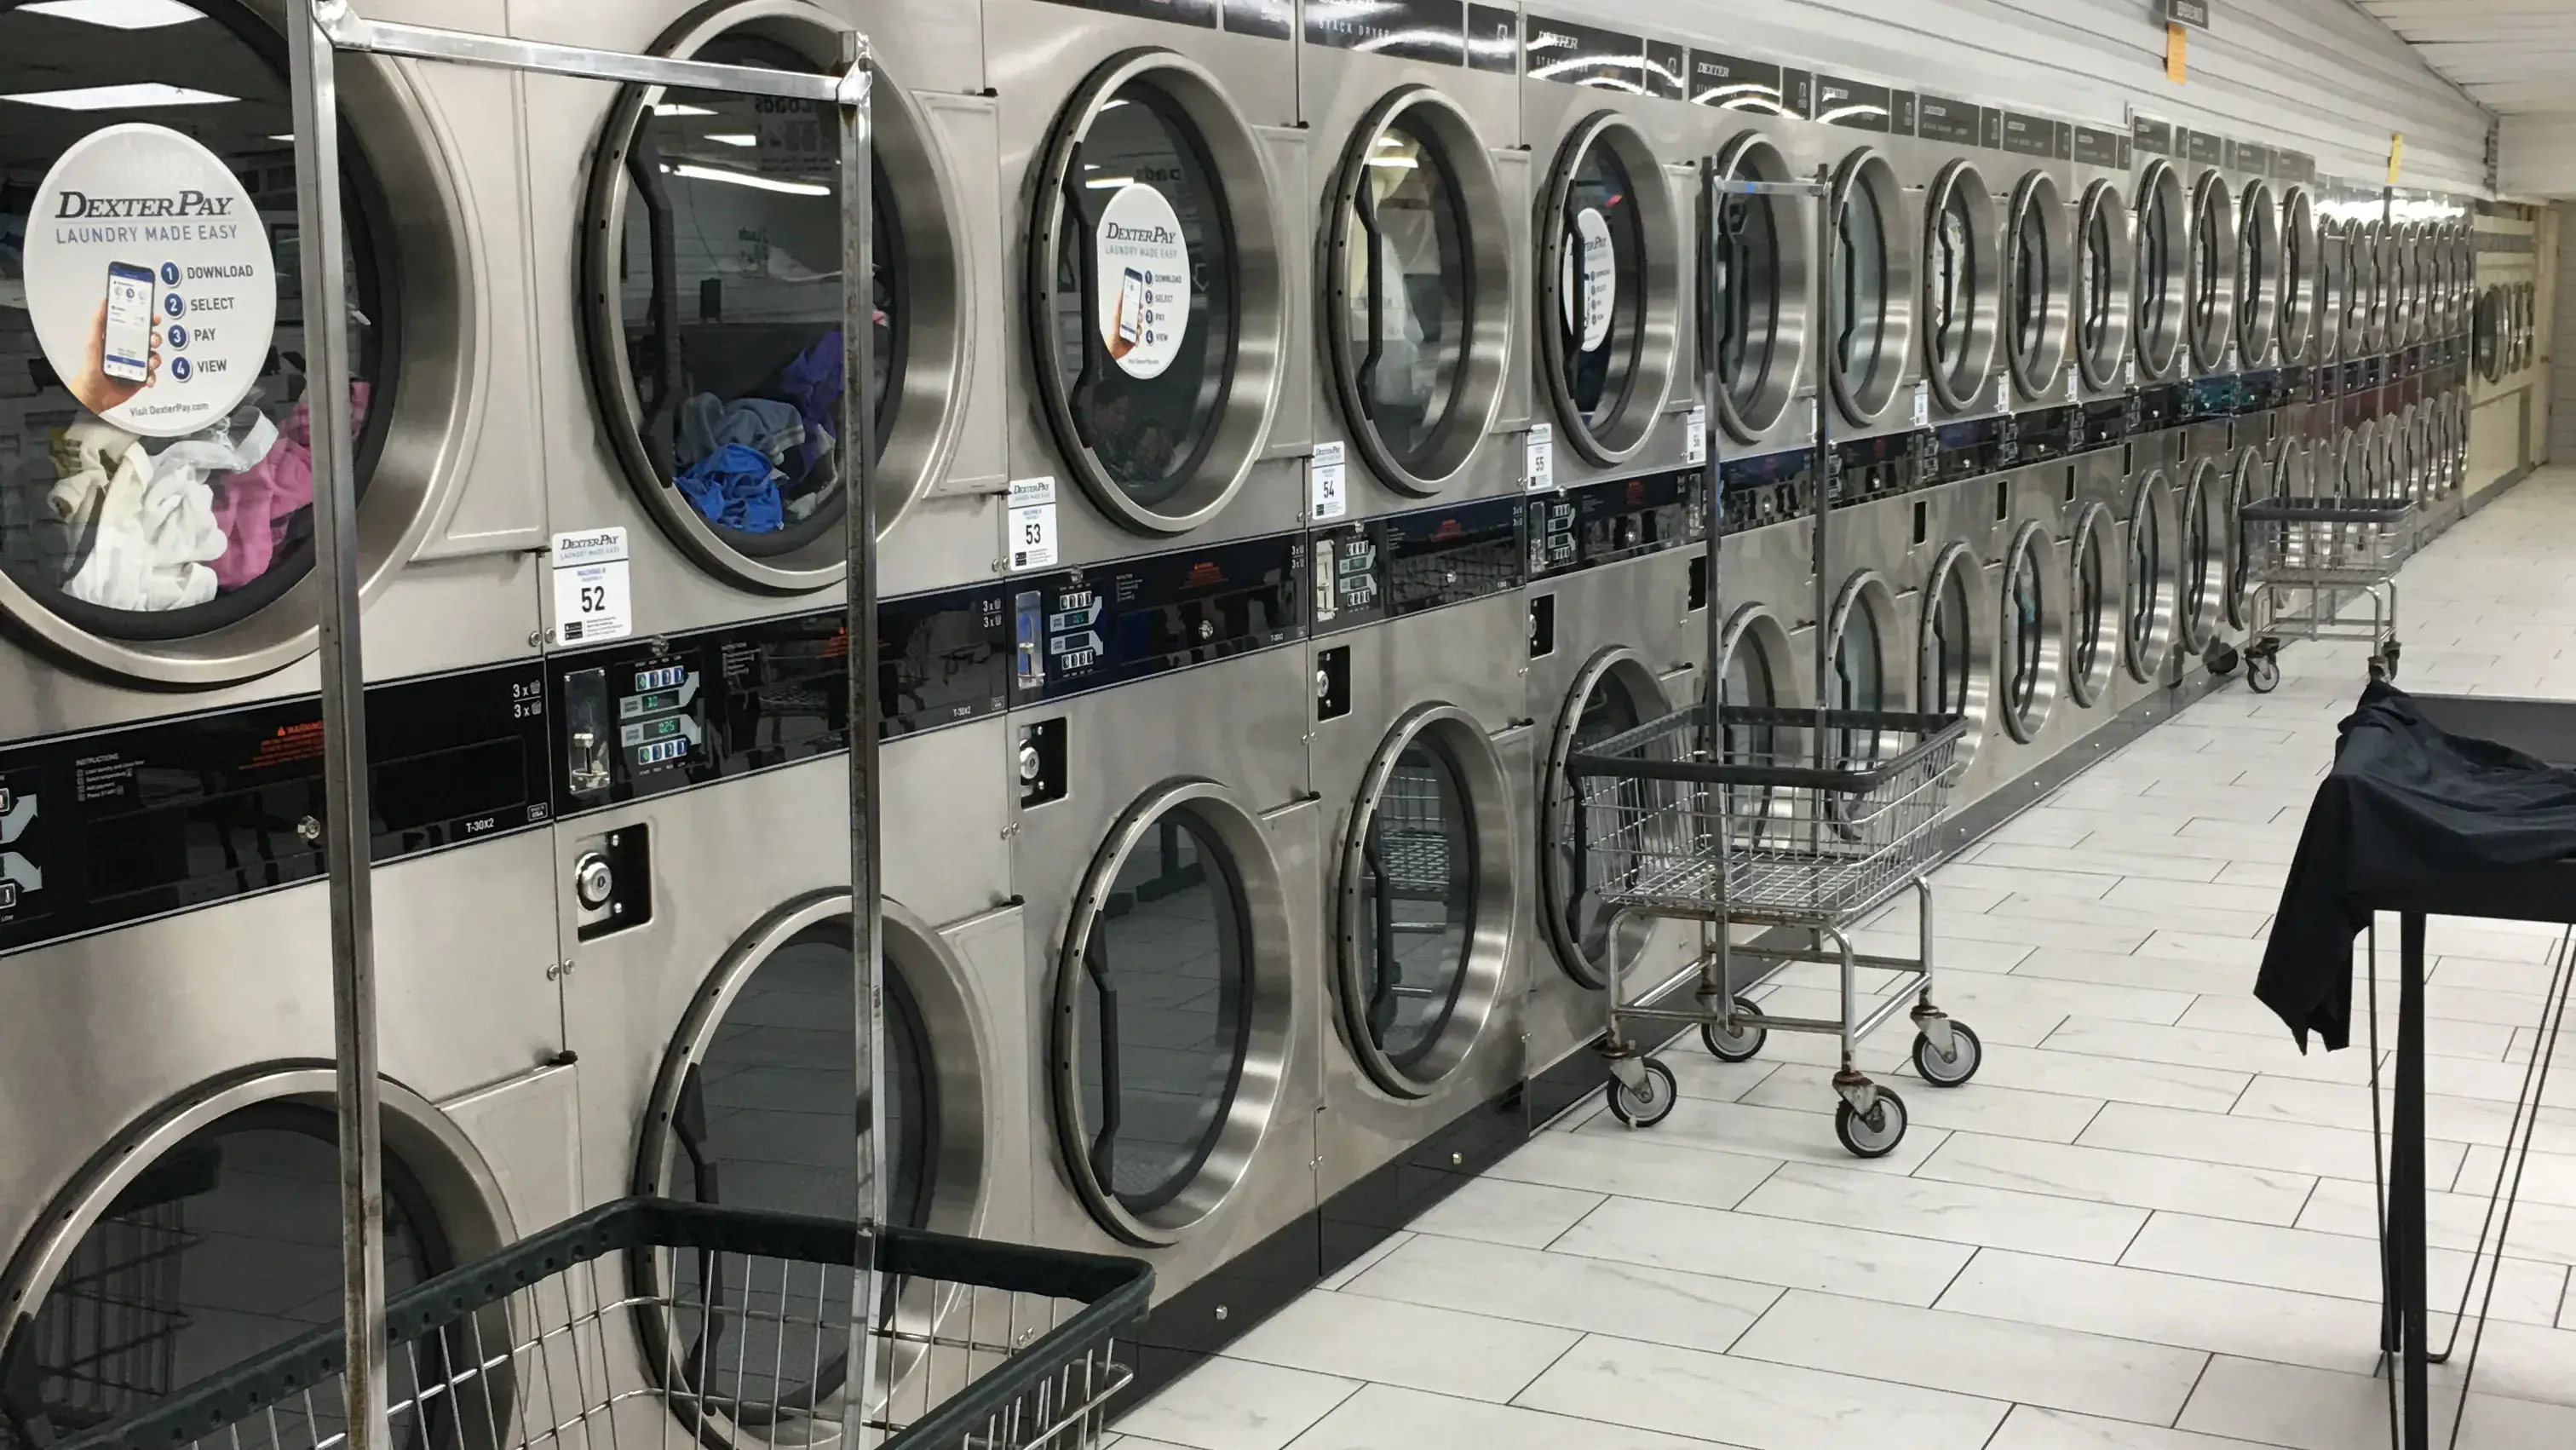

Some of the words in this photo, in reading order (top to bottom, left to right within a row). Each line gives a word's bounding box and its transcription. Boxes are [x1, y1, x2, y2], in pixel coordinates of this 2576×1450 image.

[1697, 61, 1730, 78] DEXTER
[56, 226, 138, 245] LAUNDRY
[145, 225, 192, 242] MADE
[198, 224, 238, 240] EASY
[1105, 244, 1137, 256] LAUNDRY
[1140, 247, 1159, 258] MADE
[1160, 248, 1177, 259] EASY
[187, 265, 254, 280] DOWNLOAD
[1155, 273, 1182, 284] DOWNLOAD
[170, 298, 178, 313] 2
[191, 297, 234, 312] SELECT
[1155, 294, 1174, 303] SELECT
[1155, 313, 1164, 322] PAY
[174, 329, 181, 343] 3
[194, 328, 216, 342] PAY
[1156, 332, 1169, 342] VIEW
[176, 361, 185, 375] 4
[197, 360, 227, 373] VIEW
[129, 406, 147, 417] Visit
[149, 402, 209, 416] DexterPay.com
[1535, 456, 1544, 472] 55
[1323, 480, 1335, 498] 54
[1026, 523, 1041, 545] 53
[581, 585, 606, 613] 52
[983, 600, 988, 612] 3
[983, 616, 989, 628] 3
[513, 683, 520, 698] 3
[522, 686, 529, 696] x
[514, 704, 521, 718] 3
[524, 706, 530, 716] x
[76, 753, 119, 766] INSTRUCTIONS
[465, 817, 494, 833] T-30X2
